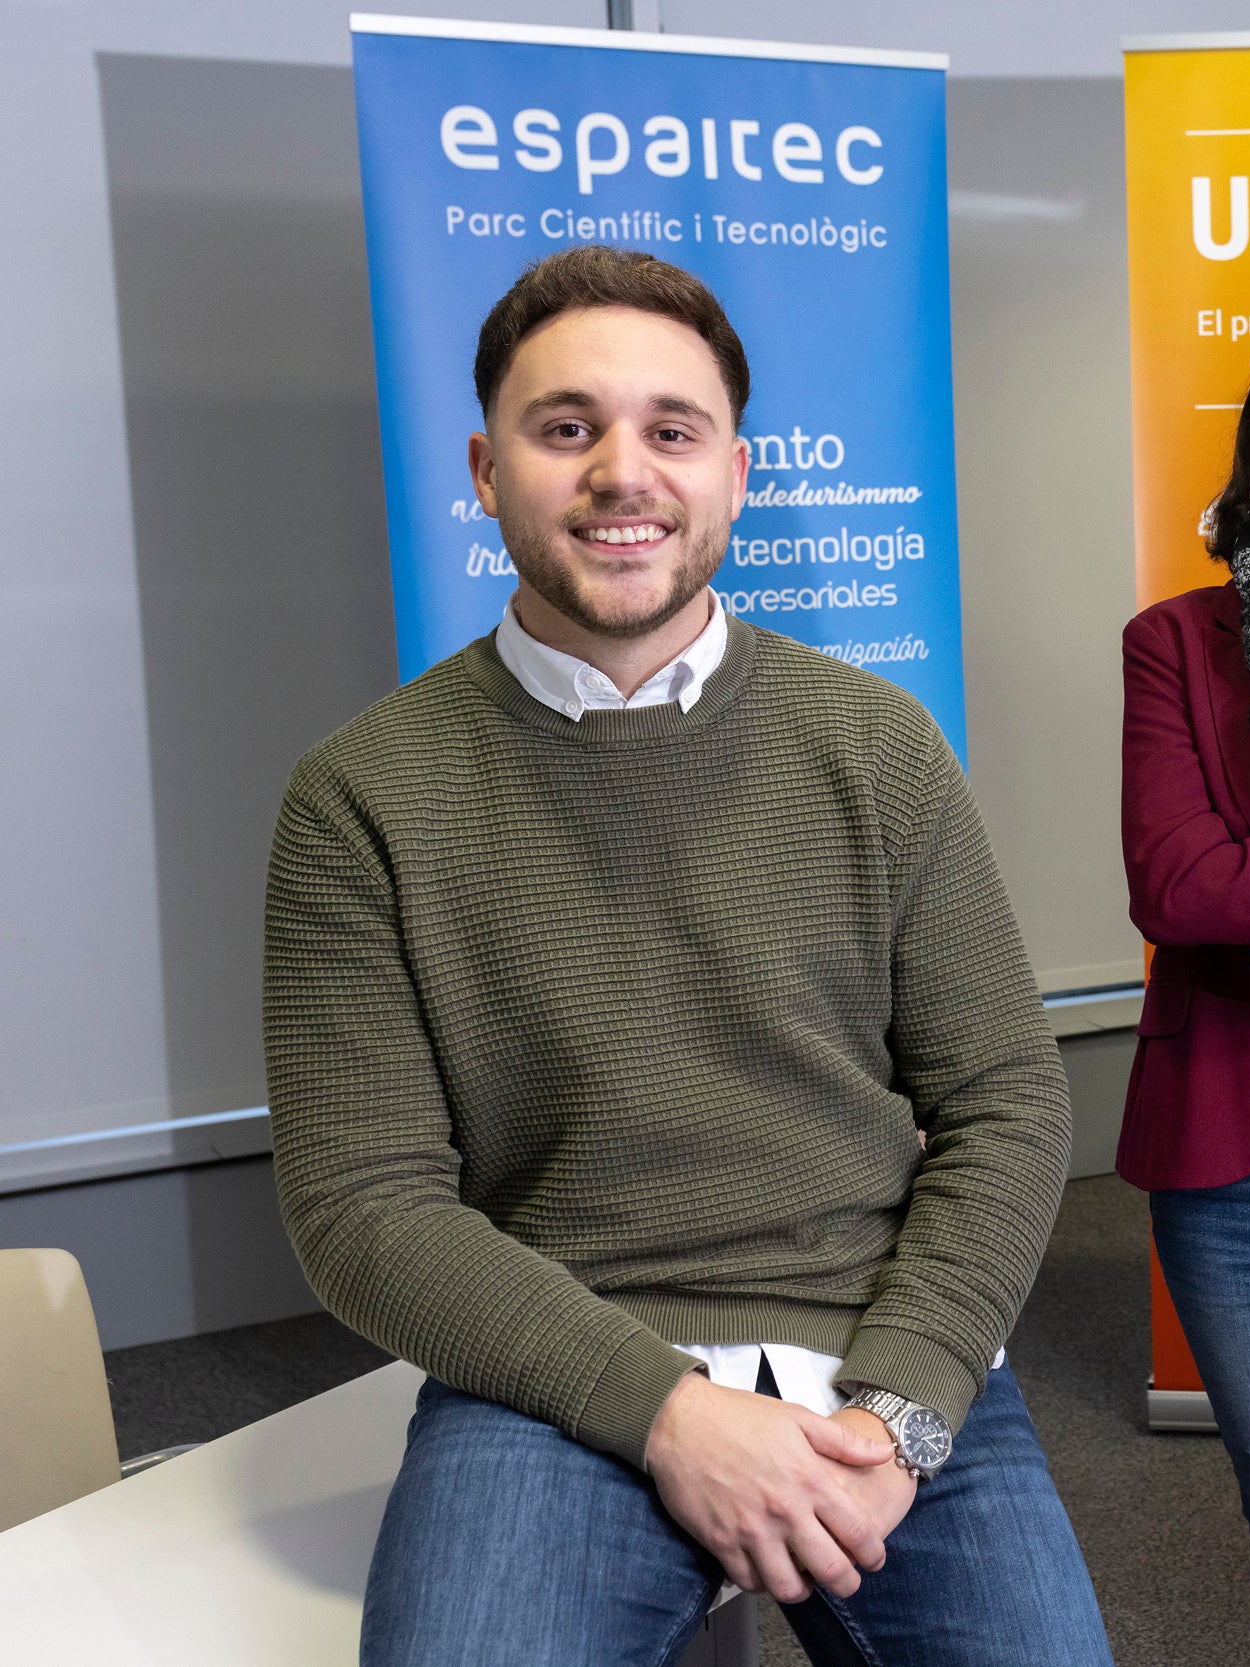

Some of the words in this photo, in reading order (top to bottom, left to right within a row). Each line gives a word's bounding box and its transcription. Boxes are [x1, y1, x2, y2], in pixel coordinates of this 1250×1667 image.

[440, 105, 884, 195] espaitec
[446, 205, 526, 237] Parc
[540, 208, 682, 242] Científic
[694, 213, 703, 243] i
[713, 215, 888, 253] Tecnològic
[1197, 309, 1222, 337] El
[731, 525, 925, 571] tecnología
